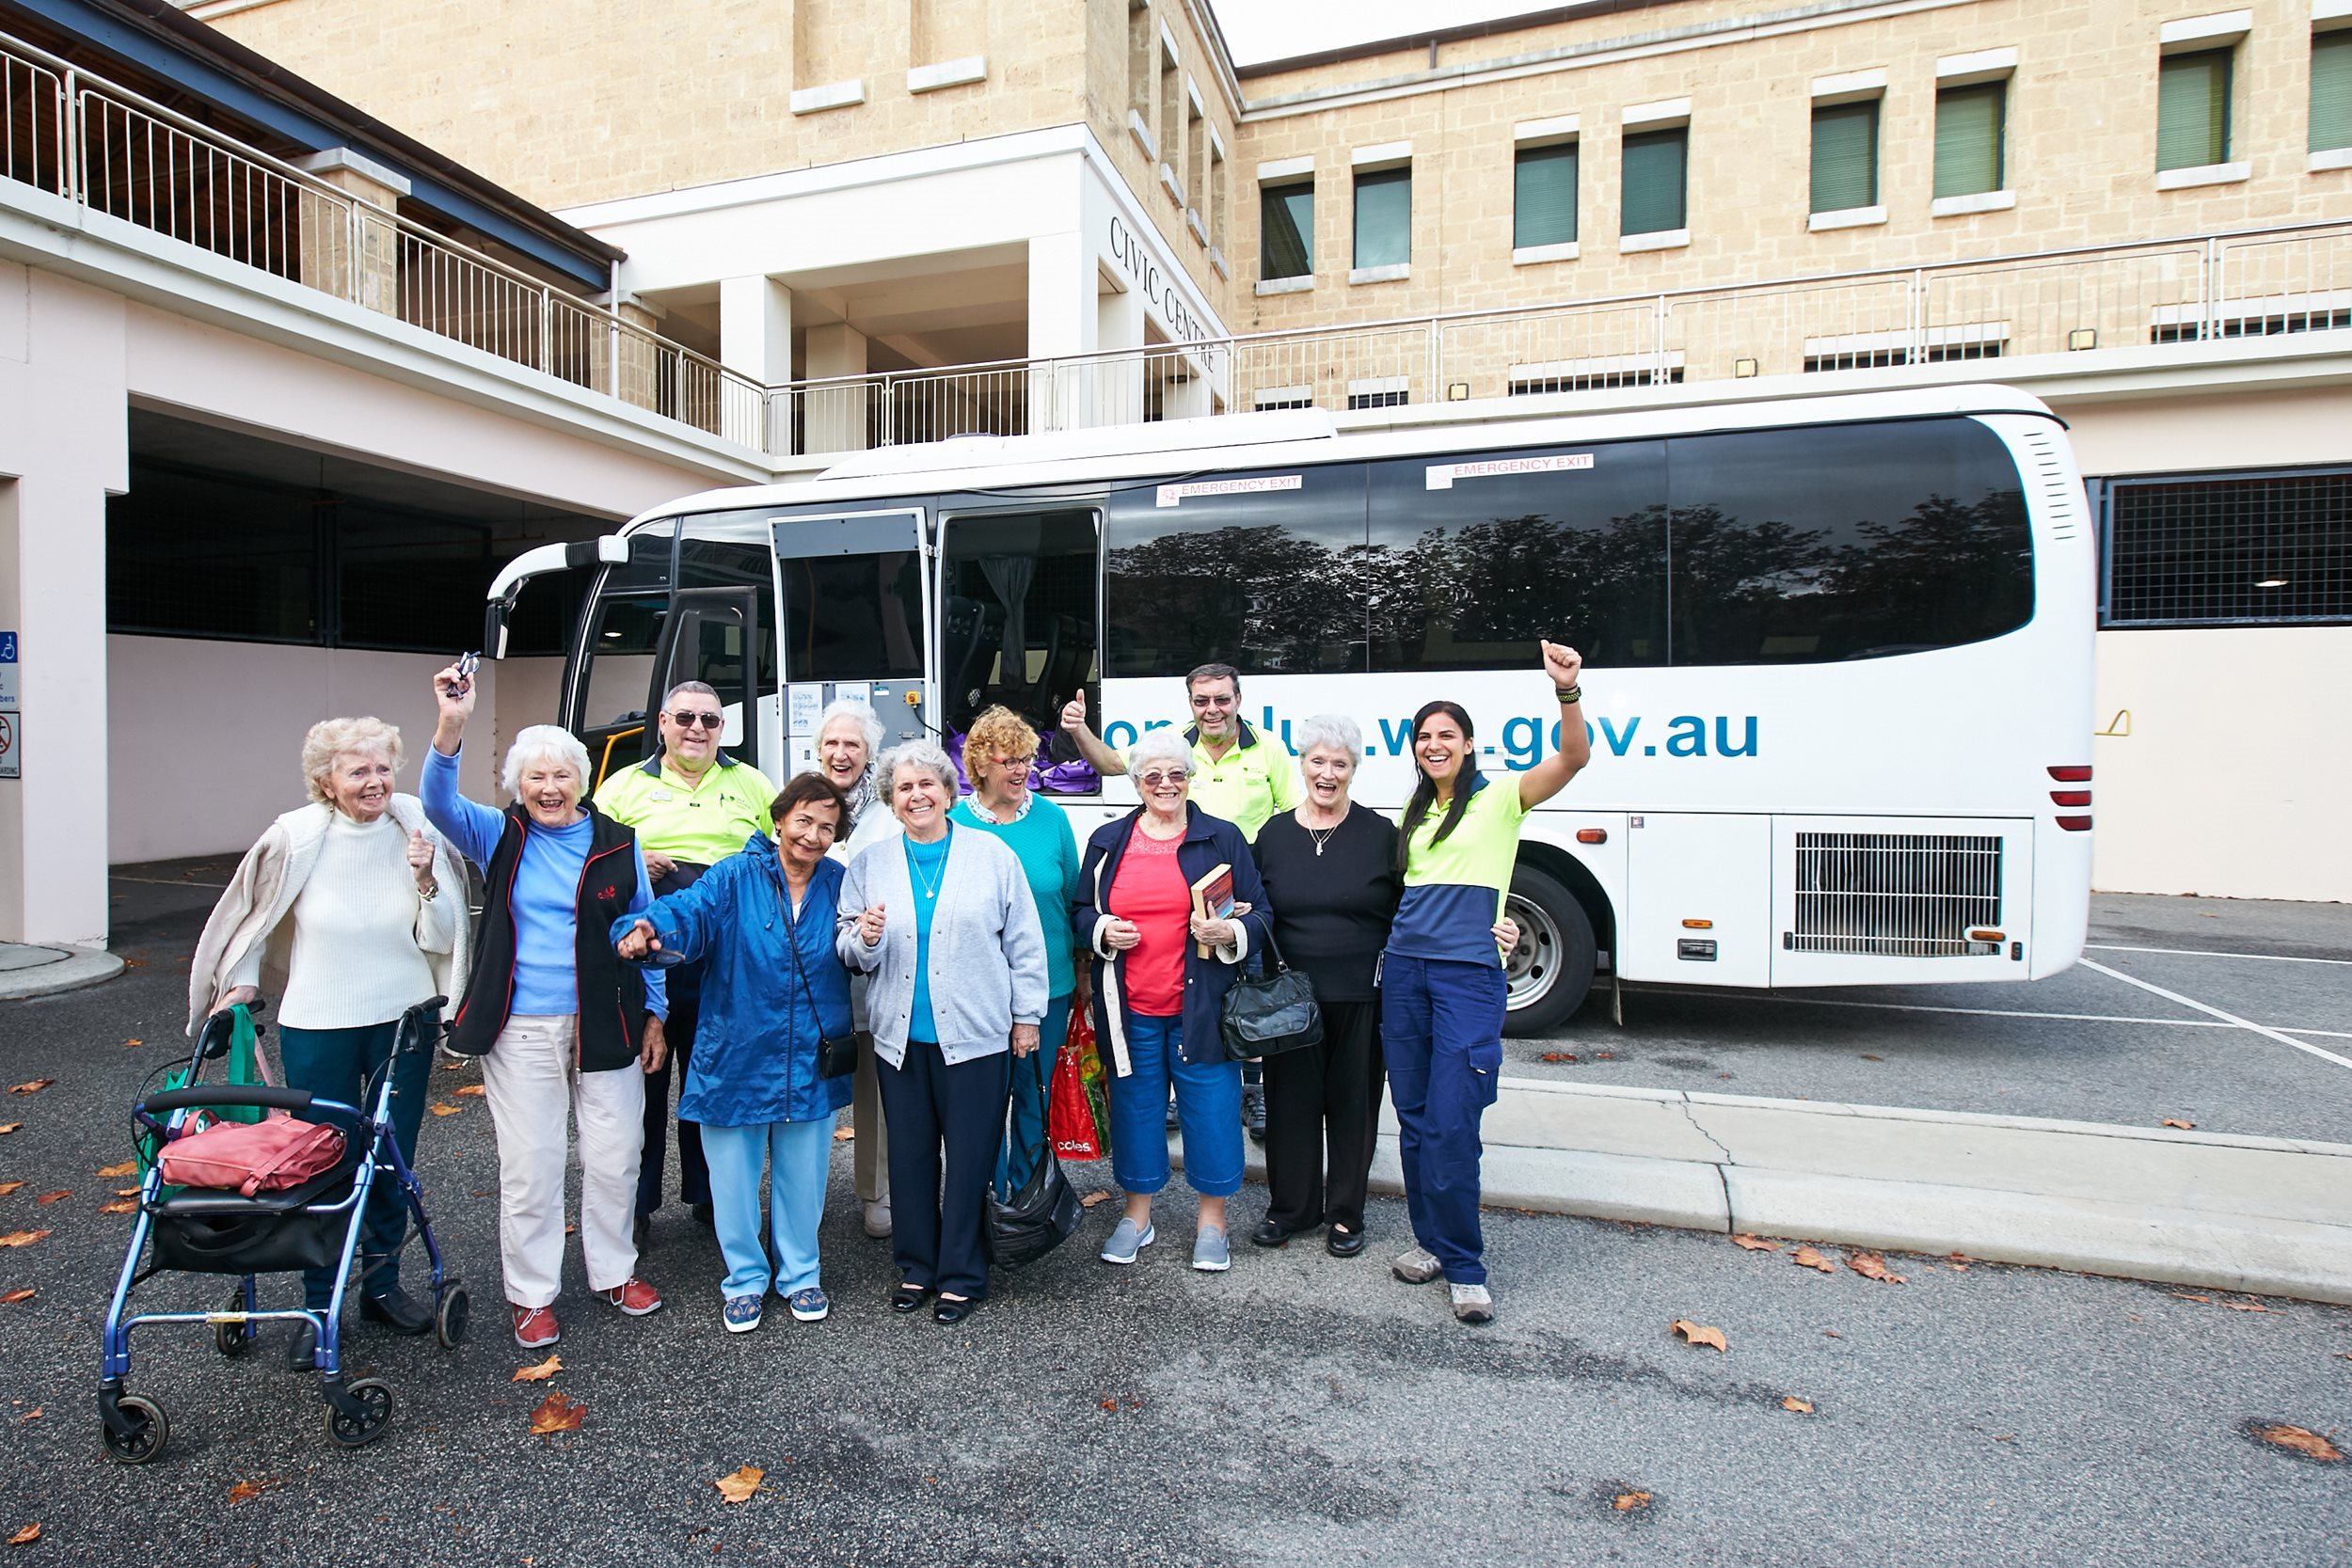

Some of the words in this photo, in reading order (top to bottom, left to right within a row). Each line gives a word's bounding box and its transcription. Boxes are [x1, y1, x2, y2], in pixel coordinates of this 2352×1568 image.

[1110, 216, 1159, 305] CIVIC
[1455, 459, 1550, 476] EMERGENCY
[1556, 456, 1590, 467] EXIT
[1182, 480, 1265, 495] EMERGENCY
[1270, 477, 1298, 488] EXIT
[1057, 1140, 1091, 1152] coles
